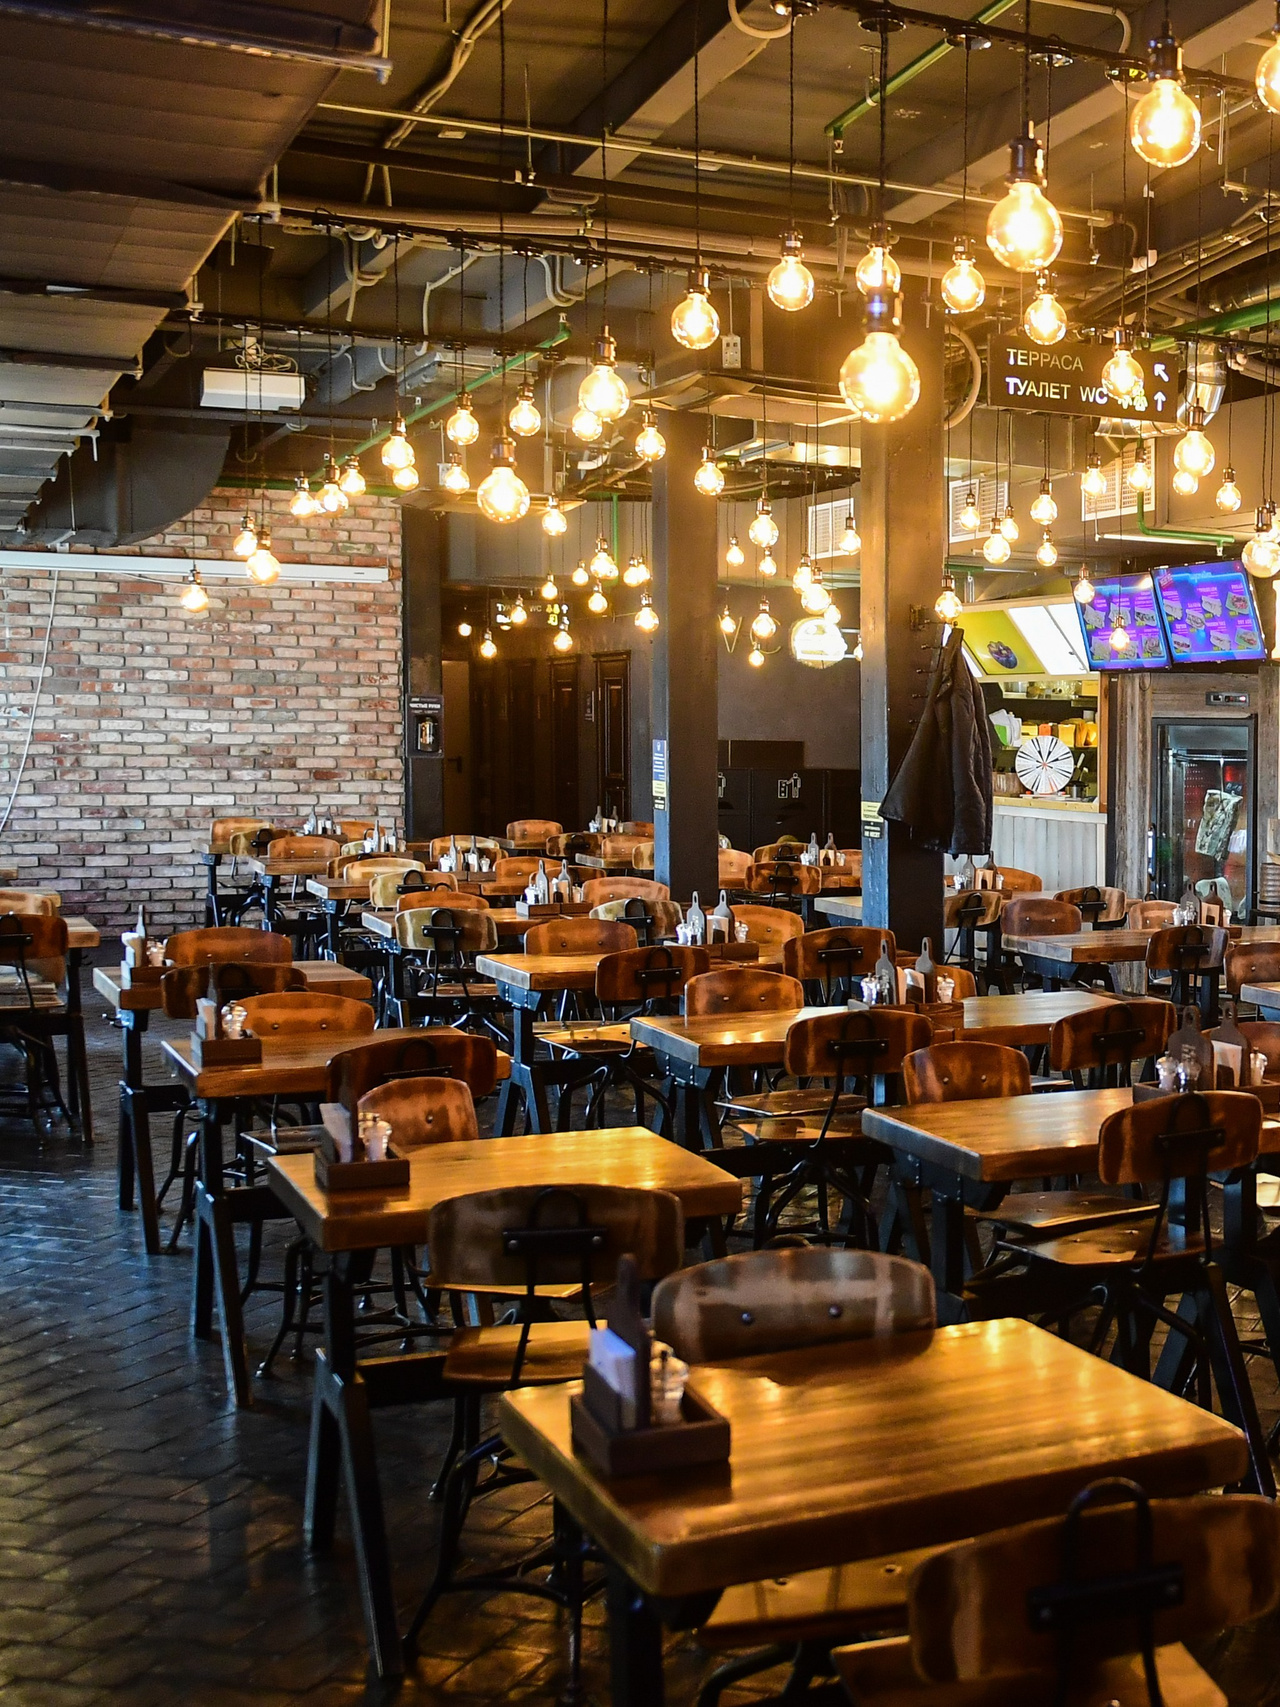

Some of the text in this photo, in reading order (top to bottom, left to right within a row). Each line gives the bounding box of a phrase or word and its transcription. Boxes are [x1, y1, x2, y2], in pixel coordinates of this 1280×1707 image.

[1006, 348, 1084, 372] ТЕРРАСА
[1005, 377, 1071, 400] ТУАЛЕТ
[1080, 386, 1108, 405] WC
